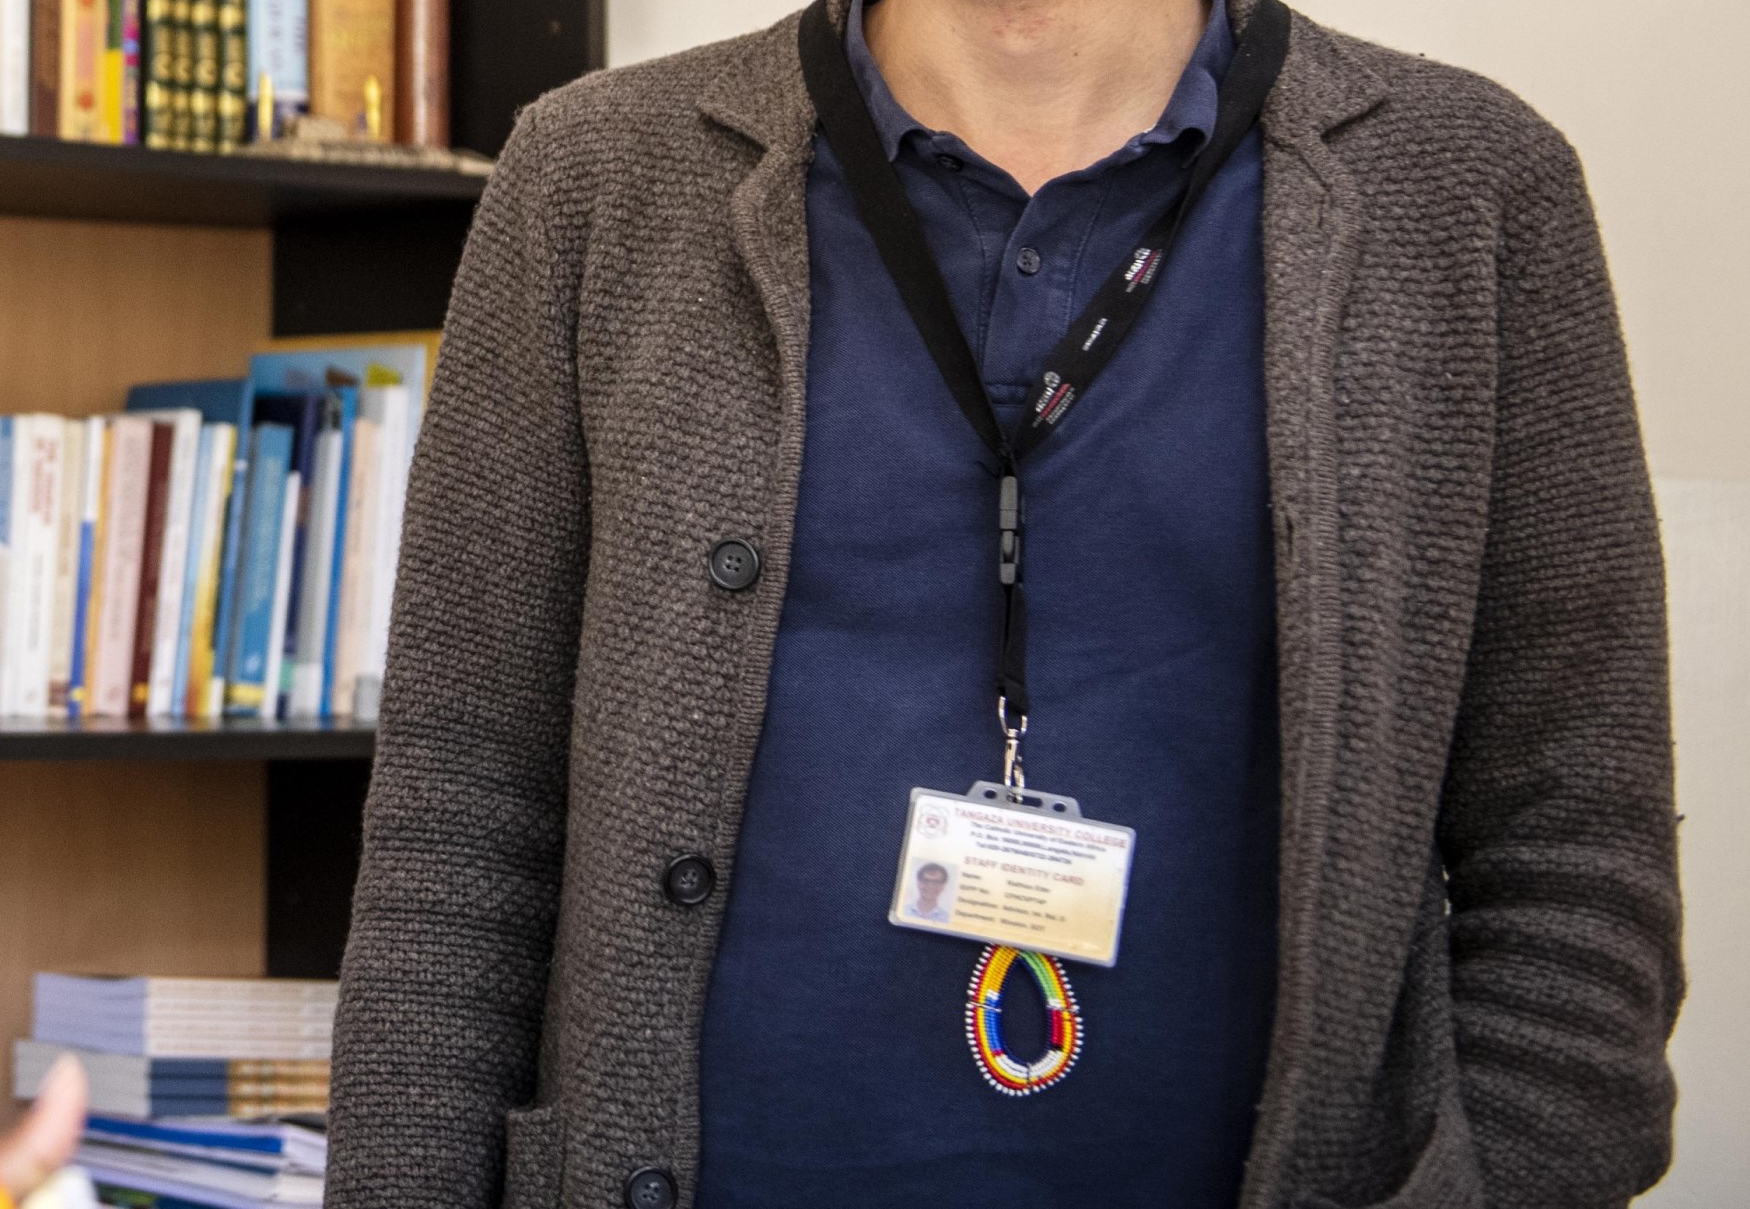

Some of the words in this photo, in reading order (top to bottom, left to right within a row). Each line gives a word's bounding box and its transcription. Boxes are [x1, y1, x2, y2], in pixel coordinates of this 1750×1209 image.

[955, 807, 1004, 825] TANGAZA
[1006, 818, 1071, 836] UNIVERSITY
[1075, 829, 1127, 848] COLLEGE
[963, 856, 998, 869] STAFF
[1001, 862, 1051, 880] IDENTITY
[1053, 872, 1085, 886] CARD
